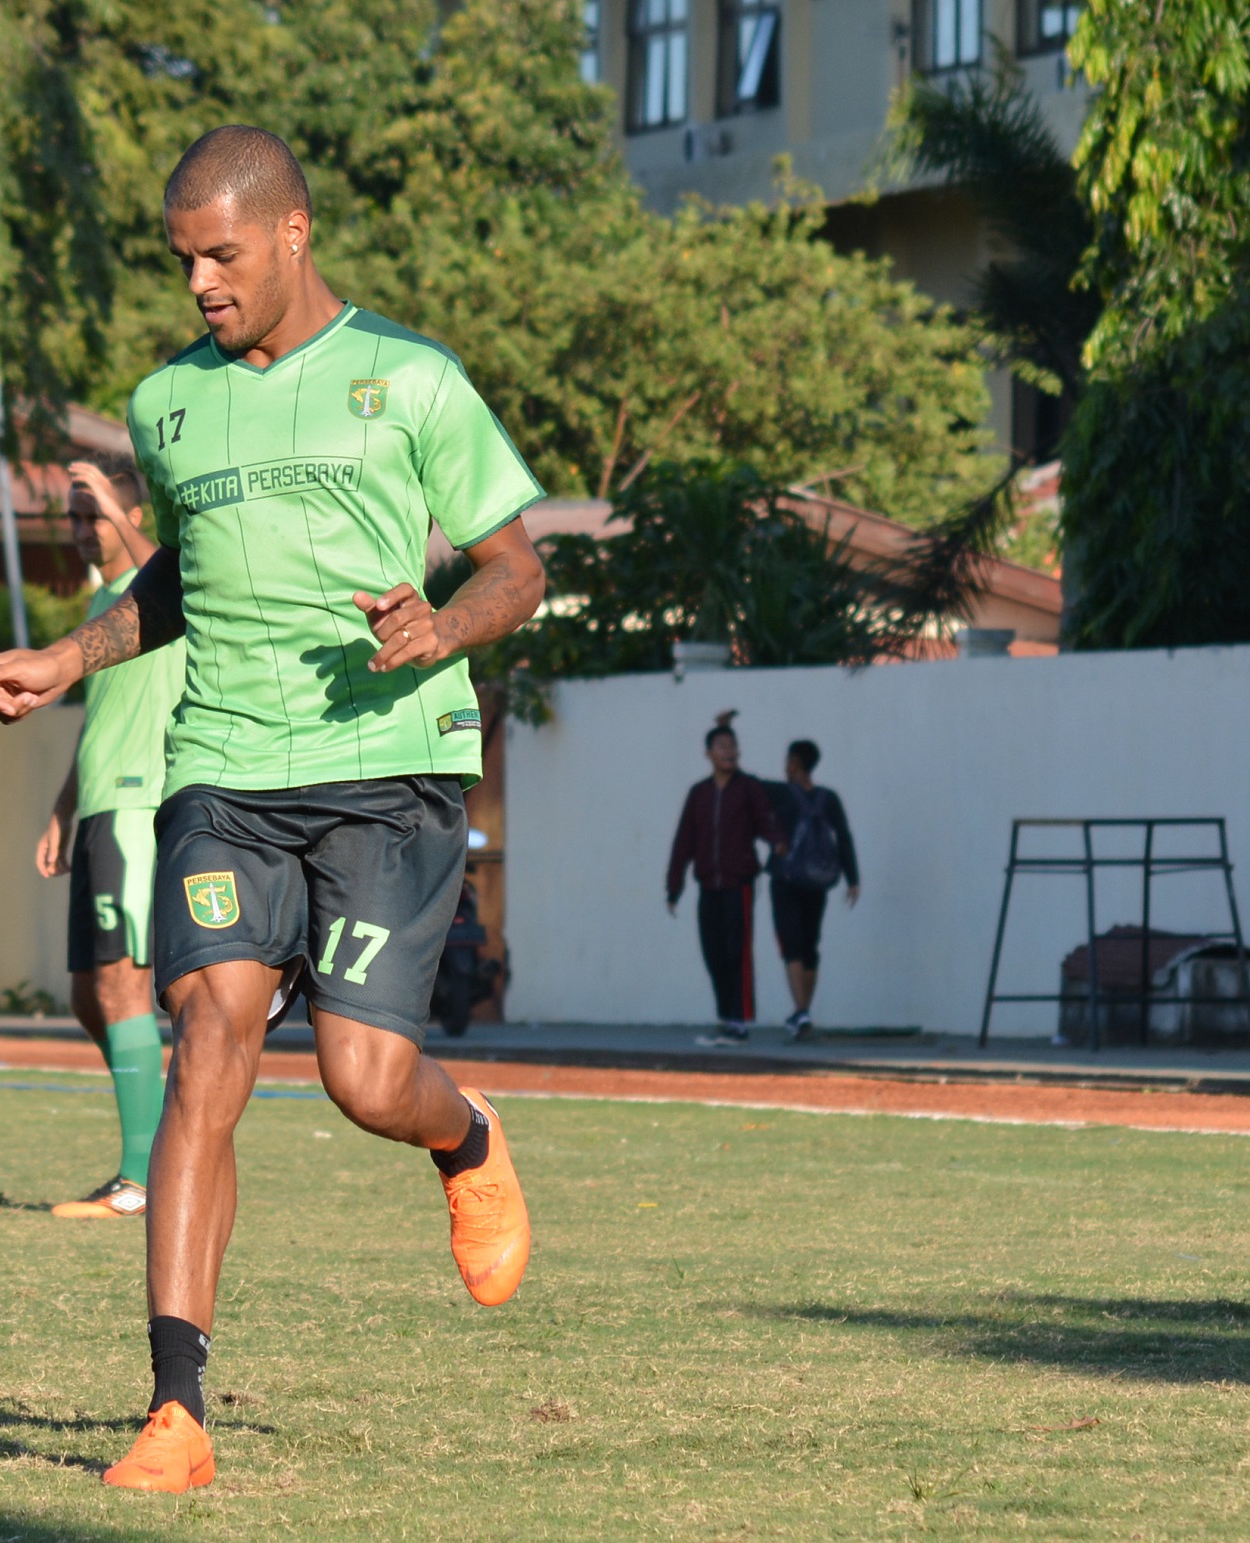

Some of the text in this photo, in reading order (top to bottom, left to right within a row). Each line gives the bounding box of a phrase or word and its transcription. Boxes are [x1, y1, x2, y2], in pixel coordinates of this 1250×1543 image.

[156, 408, 186, 451] 17
[181, 463, 354, 509] #KITA PERSEBAYA
[187, 874, 231, 885] PERSEBAYA
[95, 894, 117, 930] 5
[318, 917, 390, 985] 17
